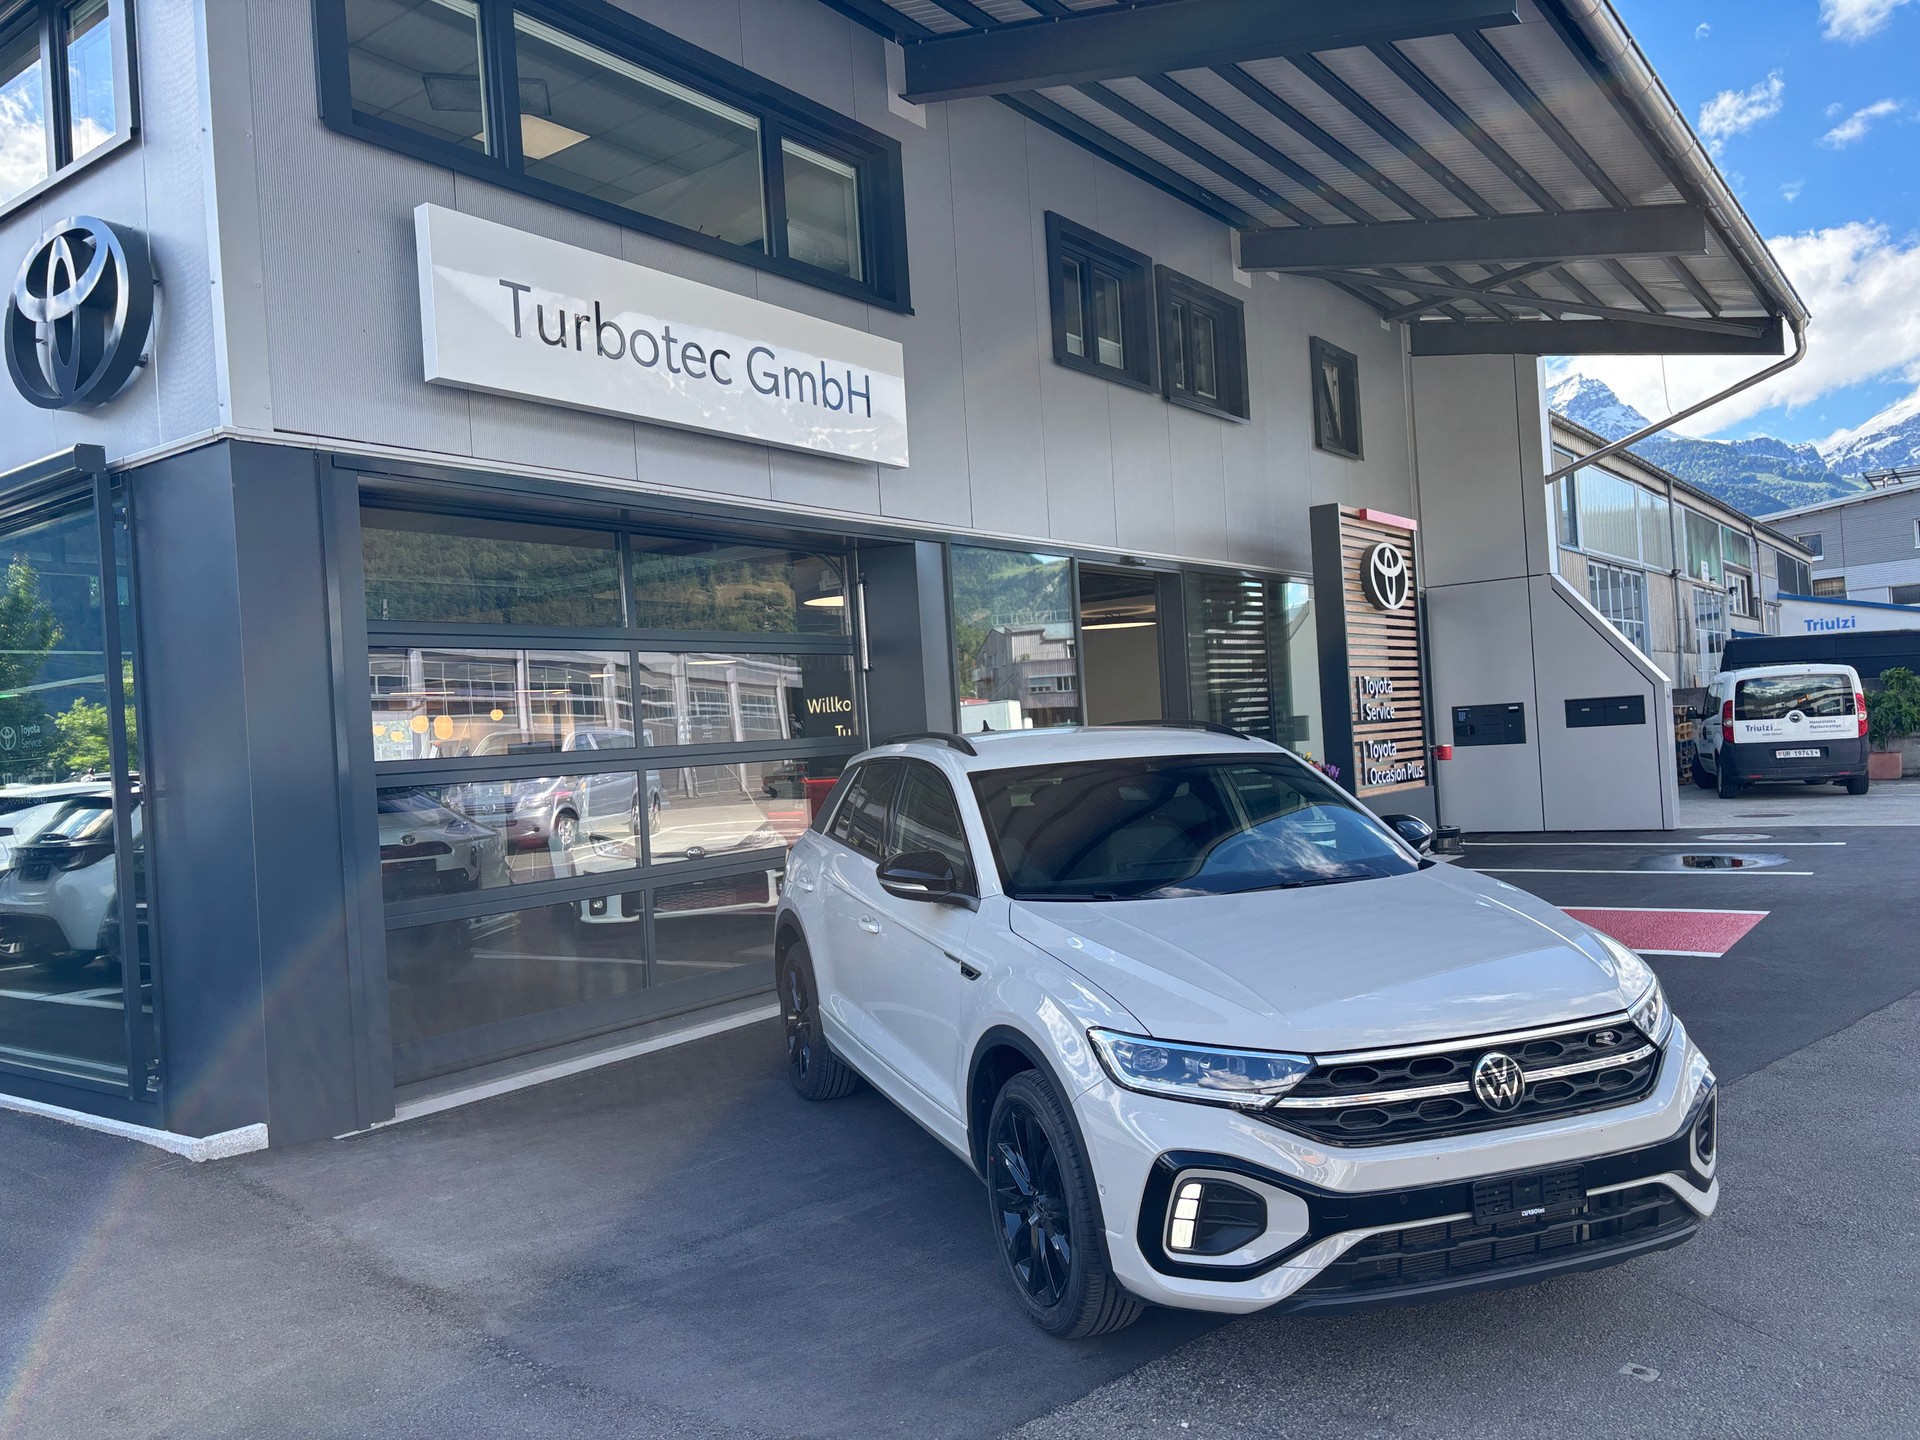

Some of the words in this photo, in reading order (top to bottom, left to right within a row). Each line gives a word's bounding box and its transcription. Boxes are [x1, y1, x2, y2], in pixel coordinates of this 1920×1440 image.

[499, 279, 734, 385] Turbotec
[746, 346, 872, 418] GmbH
[1804, 616, 1856, 631] Triulzi
[1364, 676, 1393, 698] Toyota
[1366, 703, 1395, 720] Service
[20, 724, 41, 736] Toyota
[1745, 724, 1774, 732] Triulzi
[22, 739, 42, 748] Service
[1368, 740, 1397, 762] Toyota
[1370, 764, 1407, 785] Occasion
[1407, 762, 1423, 780] Plus
